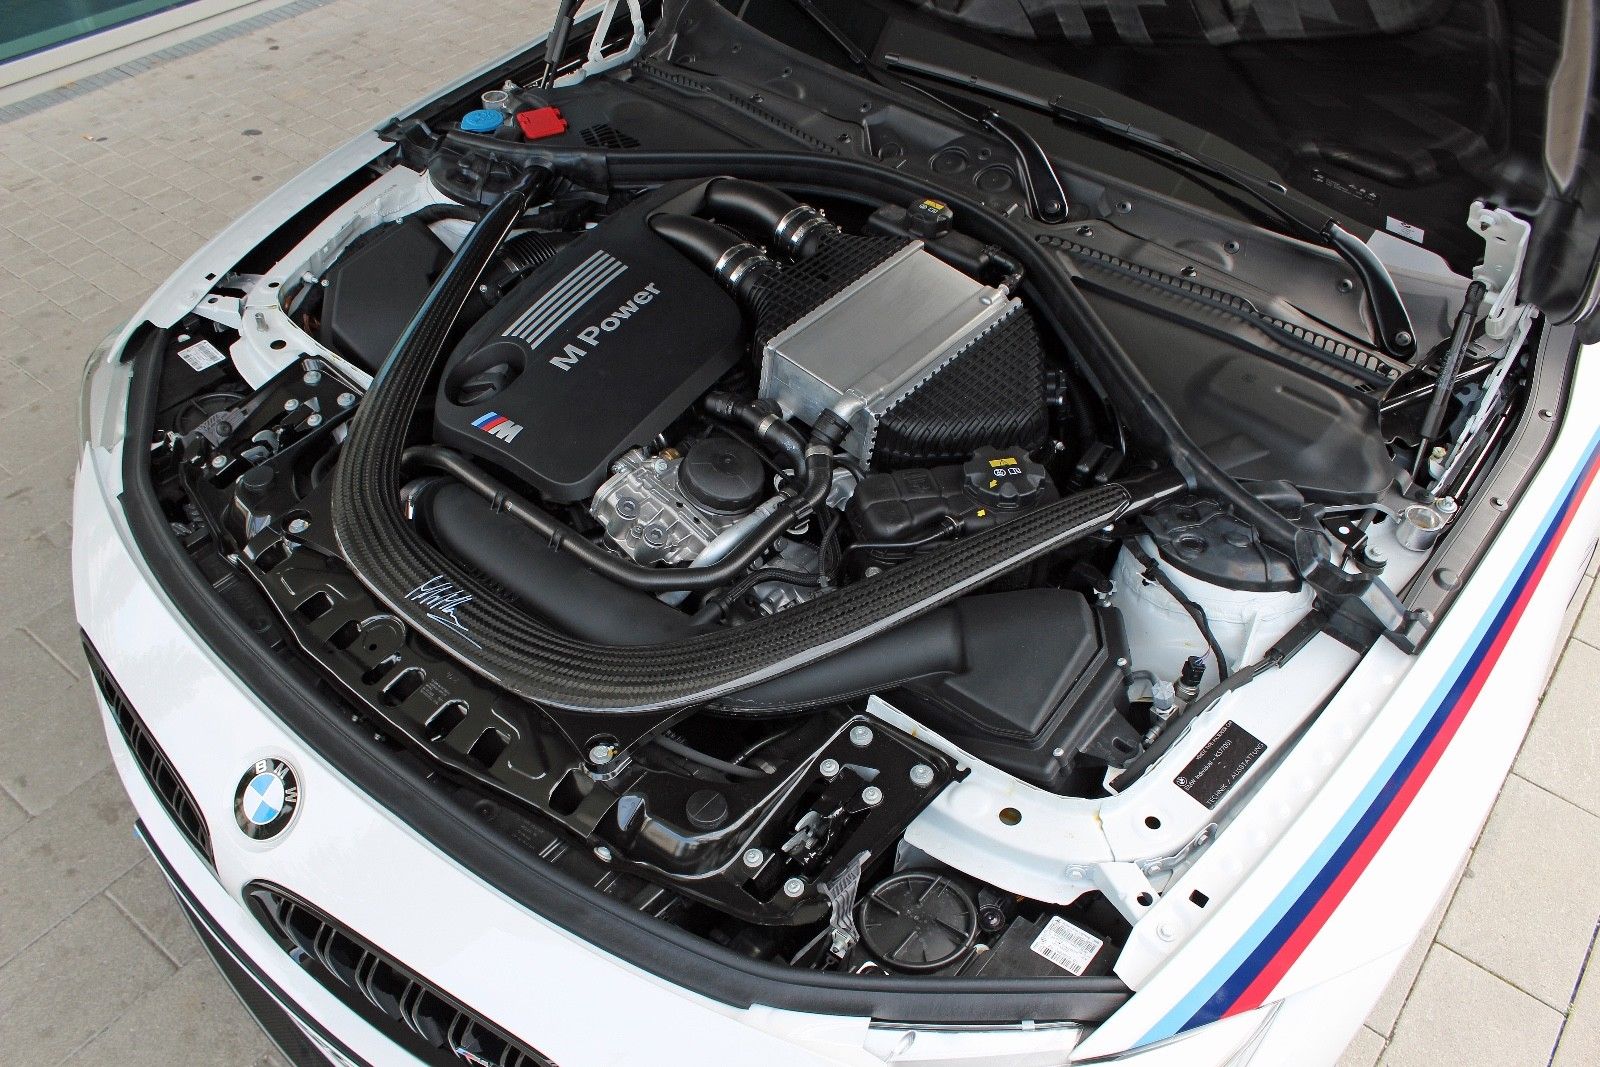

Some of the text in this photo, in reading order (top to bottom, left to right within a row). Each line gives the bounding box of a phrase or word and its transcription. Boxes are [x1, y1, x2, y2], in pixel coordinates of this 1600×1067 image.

[549, 282, 660, 371] M Power
[255, 760, 298, 803] BMW
[1206, 783, 1228, 805] TECHNIK
[1231, 743, 1264, 779] AUSSTATTUNG
